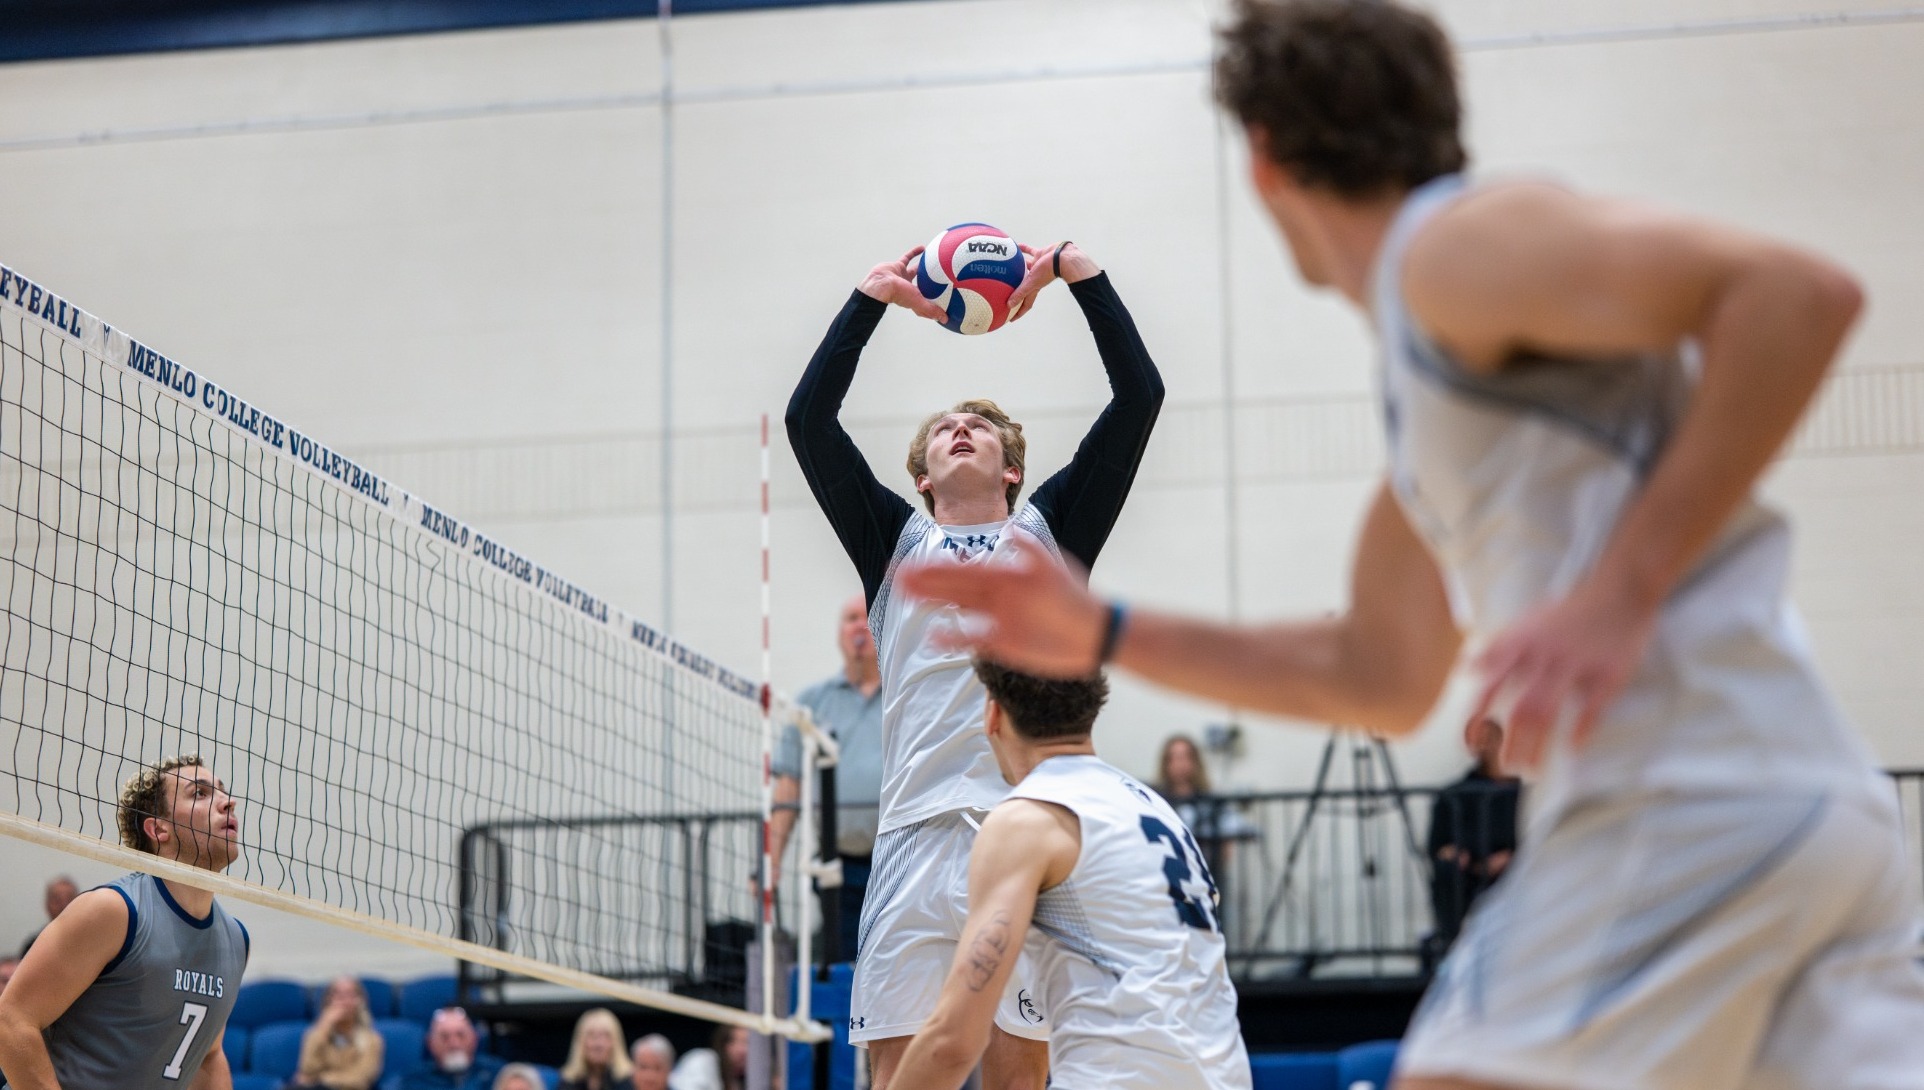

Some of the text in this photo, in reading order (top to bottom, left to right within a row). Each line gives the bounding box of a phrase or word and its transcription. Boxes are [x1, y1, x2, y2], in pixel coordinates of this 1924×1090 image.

[968, 242, 1008, 257] NCAA
[970, 263, 1007, 275] molten
[127, 340, 390, 506] MENLO COLLEGE VOLLEYBALL
[421, 503, 469, 549] MENLO
[173, 968, 224, 999] ROYALS
[162, 1000, 210, 1081] 7
